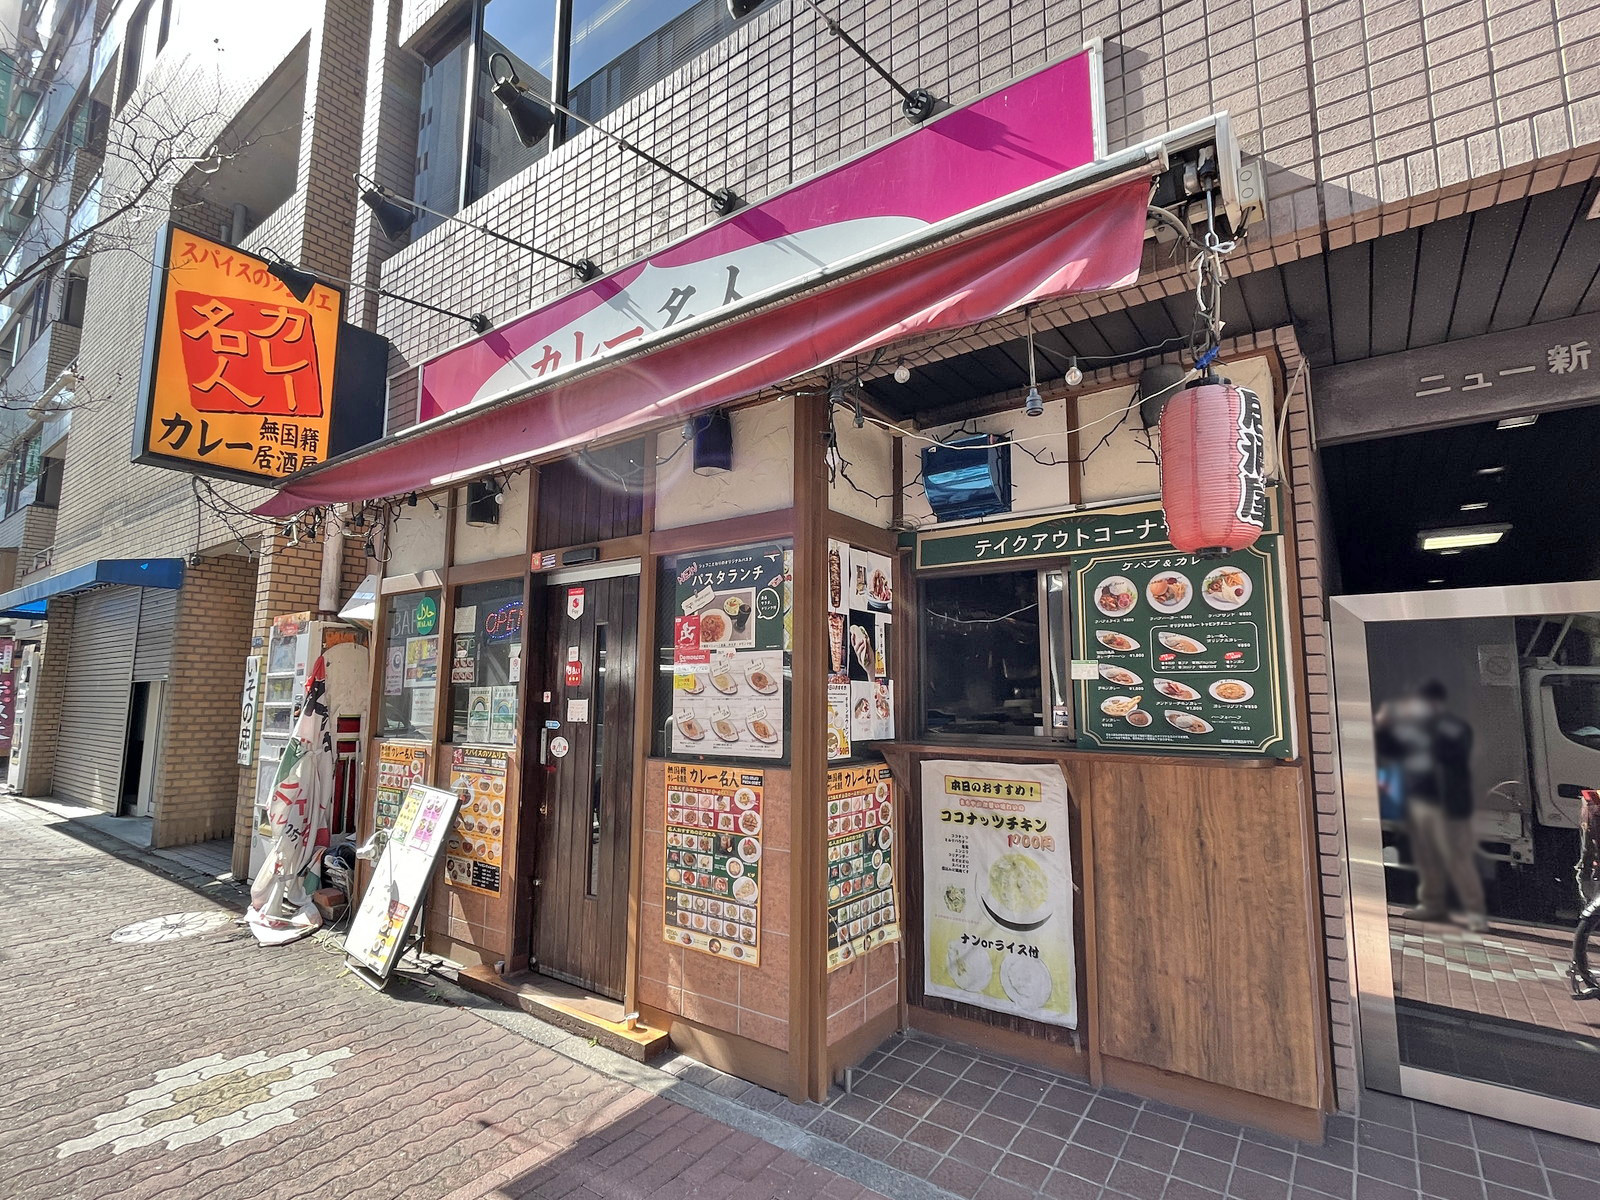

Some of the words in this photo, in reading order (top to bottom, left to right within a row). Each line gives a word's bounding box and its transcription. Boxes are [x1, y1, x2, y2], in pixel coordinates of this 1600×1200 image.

[182, 299, 265, 407] 名人
[1415, 341, 1591, 397] ニュー新
[157, 412, 253, 456] カレー
[259, 417, 320, 453] 無国籍
[974, 518, 1166, 558] テイクアウトコーナ
[691, 565, 764, 586] パスタランチ
[464, 749, 507, 760] スパイスのソムリエ
[690, 768, 739, 788] カレー名人
[845, 769, 878, 788] カレー名人
[941, 810, 1047, 833] ココナッツチキン
[961, 933, 1040, 959] ナンorライス付
